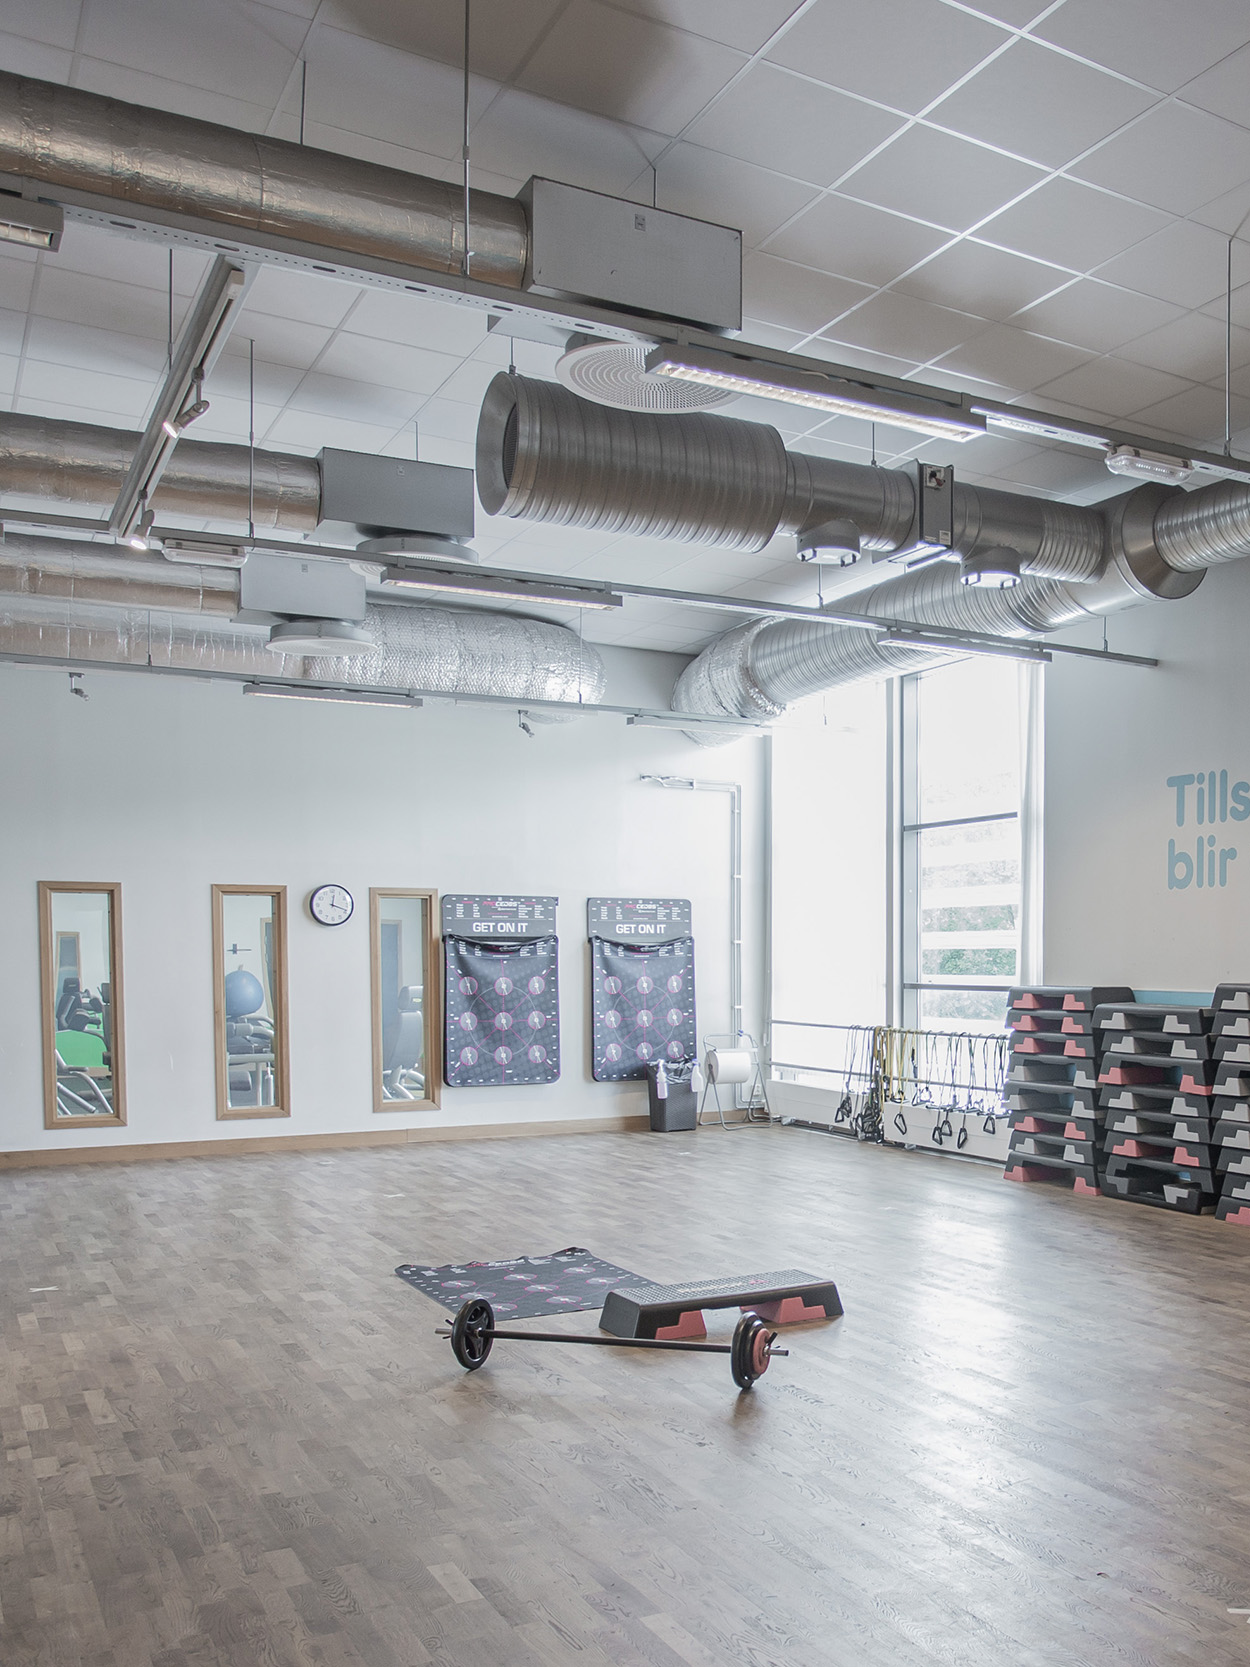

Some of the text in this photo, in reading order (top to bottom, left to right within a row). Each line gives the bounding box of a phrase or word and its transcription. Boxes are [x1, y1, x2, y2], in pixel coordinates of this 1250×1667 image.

[1167, 834, 1238, 890] blir
[472, 922, 528, 933] GET ON IT
[615, 924, 667, 934] GET ON IT
